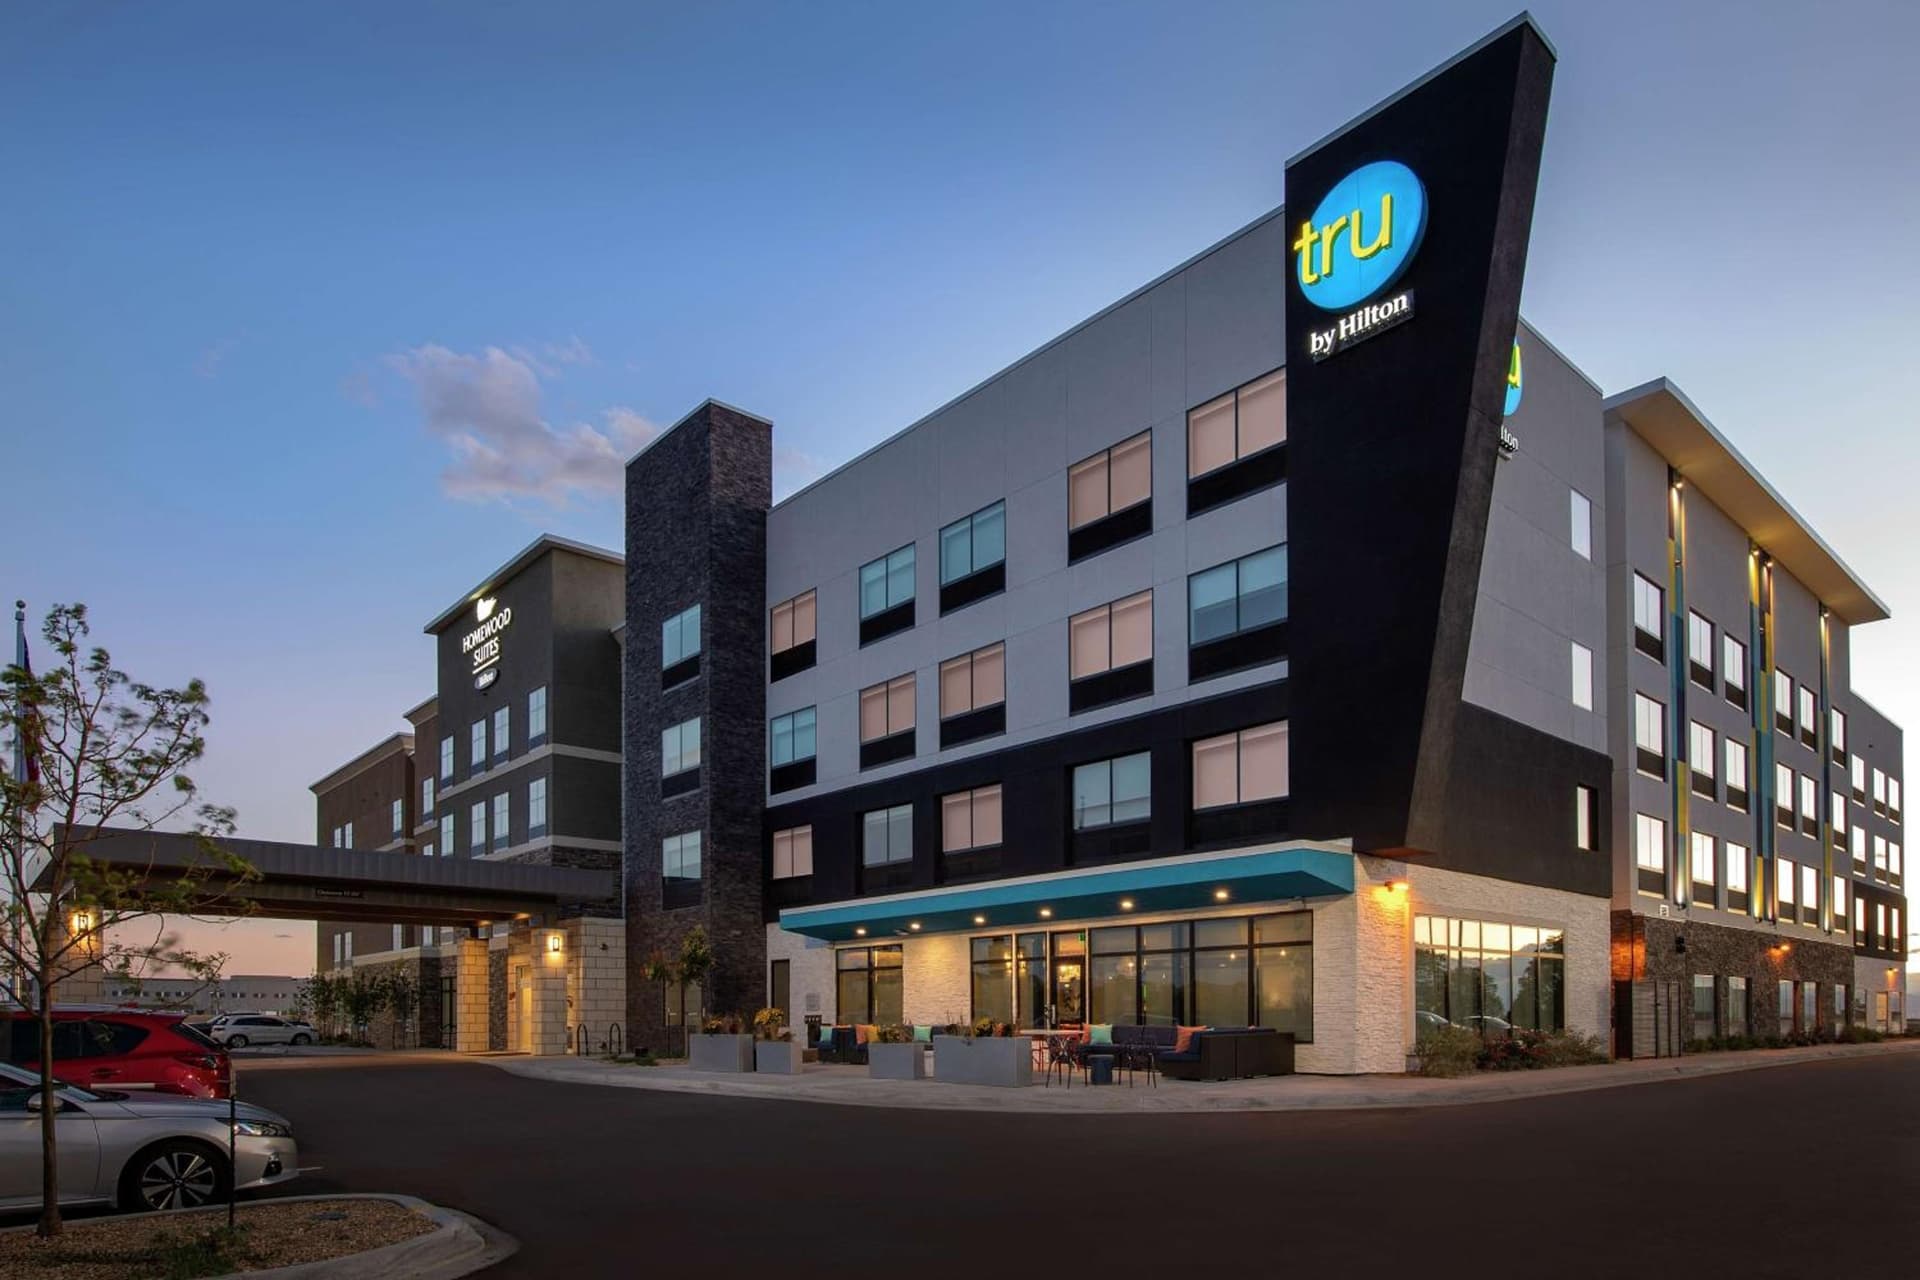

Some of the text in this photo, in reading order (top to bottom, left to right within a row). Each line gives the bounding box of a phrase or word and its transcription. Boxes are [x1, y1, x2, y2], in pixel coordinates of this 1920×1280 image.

[1294, 193, 1393, 285] tru
[1310, 294, 1409, 354] by Hilton
[1500, 424, 1519, 450] lton
[462, 607, 511, 654] HOMEWOOD
[473, 636, 500, 667] SUITES
